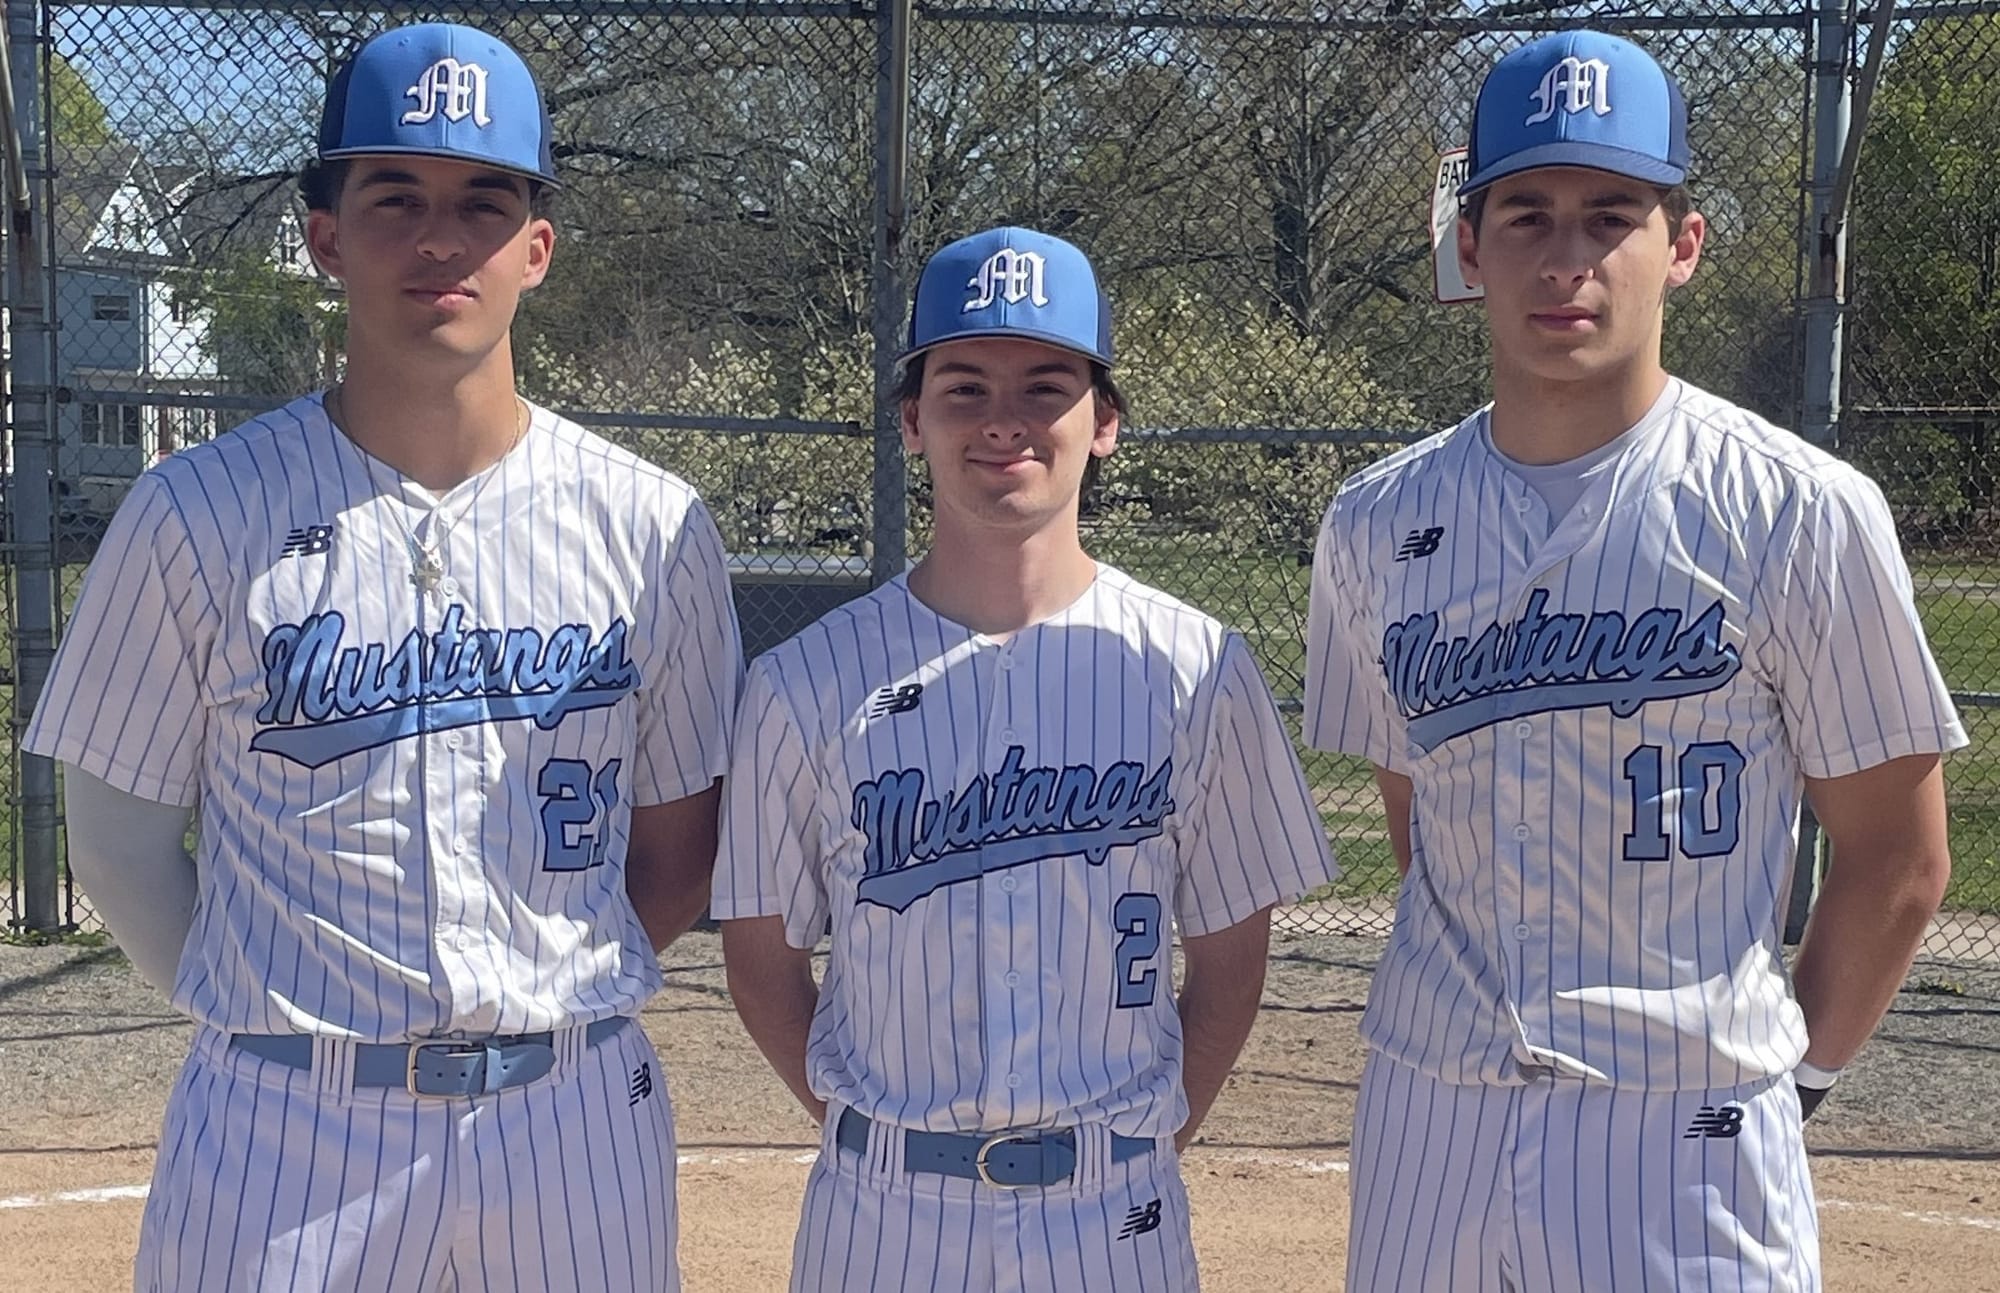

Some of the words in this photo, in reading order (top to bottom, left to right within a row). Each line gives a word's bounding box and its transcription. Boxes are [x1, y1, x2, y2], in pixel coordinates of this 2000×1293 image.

[399, 57, 493, 129] M
[1524, 55, 1613, 128] M
[961, 247, 1049, 315] M
[254, 603, 642, 731] Mustangs
[1379, 588, 1742, 718] Mustangs
[537, 757, 623, 873] 21
[850, 744, 1176, 876] Mustangs
[1622, 740, 1747, 862] 10
[1113, 892, 1162, 1009] 2
